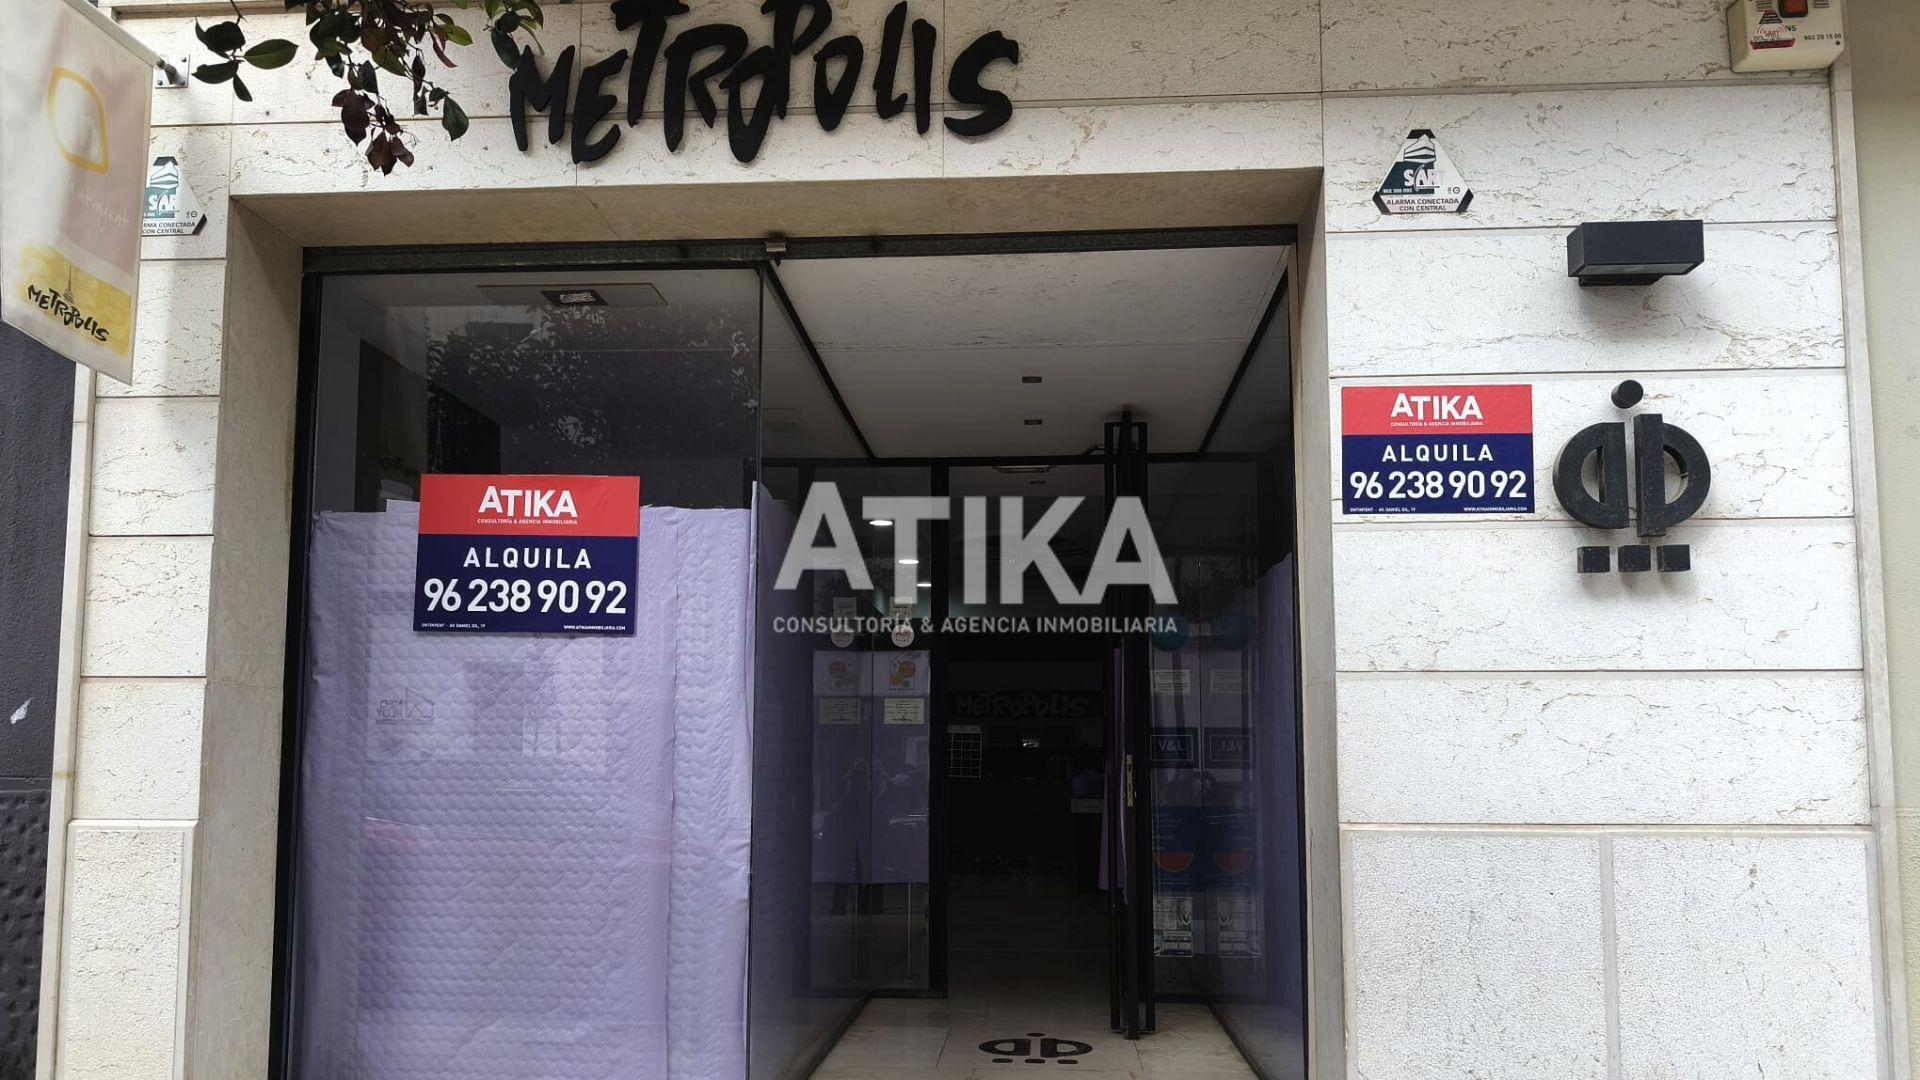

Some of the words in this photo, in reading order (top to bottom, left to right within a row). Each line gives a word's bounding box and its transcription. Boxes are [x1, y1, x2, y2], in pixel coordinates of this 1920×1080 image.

[509, 0, 1019, 164] METROPOLIS
[27, 284, 110, 342] METROPOLIS
[1390, 392, 1484, 420] ATIKA
[1382, 444, 1494, 462] ALQUILA
[1350, 472, 1384, 499] 96
[1388, 471, 1444, 499] 238
[1450, 470, 1485, 498] 90
[1490, 470, 1527, 498] 92
[478, 486, 578, 518] ATIKA
[463, 547, 592, 569] ALQUILA
[423, 578, 462, 612] 96
[467, 579, 531, 613] 238
[537, 580, 580, 613] 90
[585, 581, 627, 614] 92
